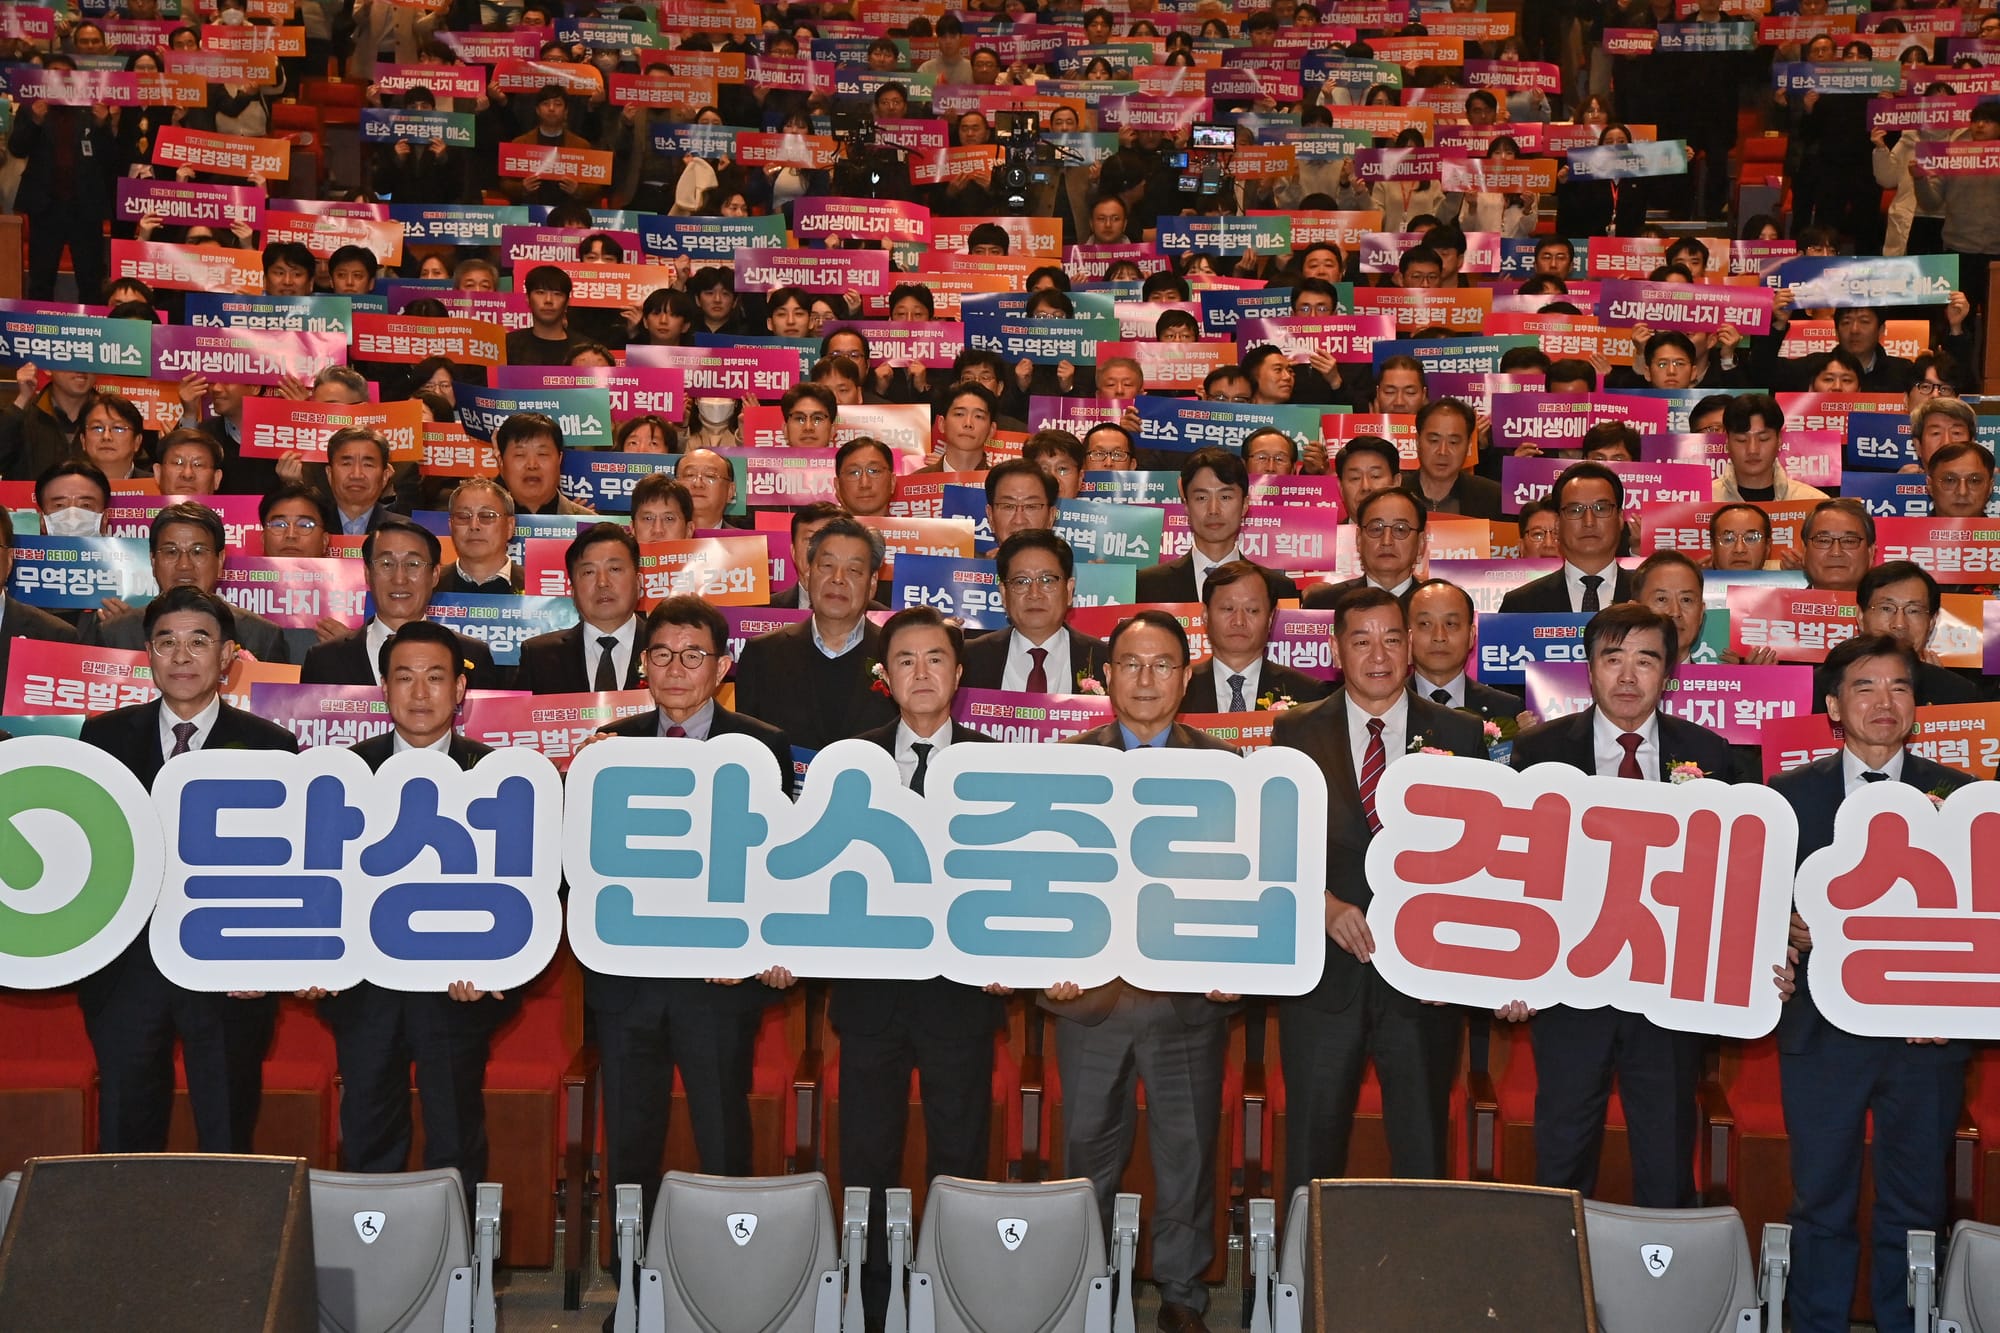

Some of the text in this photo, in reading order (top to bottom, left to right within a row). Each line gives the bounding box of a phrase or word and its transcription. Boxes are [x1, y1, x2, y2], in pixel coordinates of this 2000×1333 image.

[1304, 68, 1325, 82] 탄소
[1377, 72, 1398, 85] 해소
[1537, 75, 1556, 88] 확대
[456, 79, 480, 92] 확대
[838, 82, 860, 94] 탄소
[1873, 112, 1948, 125] 신재생에너지
[366, 122, 470, 140] 탄소 무역장벽 해소
[655, 138, 676, 150] 탄소
[920, 134, 943, 148] 확대
[159, 142, 247, 169] 글로벌경쟁력
[251, 156, 281, 172] 강화
[581, 164, 606, 178] 강화
[1526, 172, 1550, 187] 강화
[124, 197, 256, 222] 신재생에너지 확대
[429, 222, 488, 237] 무역장벽
[800, 215, 923, 235] 신재생에너지 확대
[646, 232, 678, 248] 탄소
[682, 235, 748, 251] 무역장벽
[1162, 232, 1285, 248] 탄소 무역장벽 해소
[231, 268, 264, 287] 강화
[744, 267, 880, 286] 신재생에너지 확대
[1209, 308, 1238, 325] 탄소
[1451, 307, 1483, 324] 강화
[1609, 301, 1718, 323] 신재생에너지
[1724, 307, 1762, 325] 확대
[36, 324, 102, 337] RE100 업무협약식
[13, 337, 142, 365] 무역장벽 해소
[359, 335, 499, 361] 글로벌경쟁력 강화
[971, 336, 1076, 357] 탄소 무역장벽
[1603, 338, 1635, 356] 강화
[1887, 339, 1919, 357] 강화
[159, 350, 286, 376] 신재생에너지
[754, 370, 790, 391] 확대
[496, 400, 559, 410] RE100 업무협약식
[634, 391, 673, 413] 확대
[1594, 405, 1628, 413] 업무협약식
[327, 415, 352, 425] RE100
[461, 408, 602, 437] 탄소 해소
[1211, 411, 1273, 424] RE100 업무협약식
[1140, 420, 1178, 440] 탄소
[1857, 438, 1898, 459] 탄소
[628, 464, 652, 473] RE100
[1787, 456, 1830, 477] 확대
[1282, 487, 1321, 496] 업무협약식
[1063, 512, 1107, 524] 업무협약식
[1103, 535, 1149, 558] 해소
[1275, 534, 1322, 558] 확대
[48, 550, 77, 561] RE100
[15, 567, 121, 594] 무역장벽
[249, 571, 279, 581] RE100
[703, 569, 756, 596] 강화
[954, 571, 993, 584] 힘쎈충남
[904, 586, 954, 614] 탄소
[469, 608, 498, 618] RE100
[1792, 603, 1837, 617] 힘쎈충남
[1285, 622, 1327, 635] 힘쎈충남
[1533, 627, 1576, 638] 힘쎈충남
[1482, 646, 1535, 671] 탄소
[81, 662, 131, 677] 힘쎈충남
[1683, 680, 1741, 692] 업무협약식
[532, 708, 577, 722] 힘쎈충남
[971, 704, 1045, 719] 힘쎈충남 RE100
[1208, 728, 1238, 739] RE100
[1924, 720, 1984, 733] 업무협약식
[178, 774, 535, 960] 달성
[590, 762, 1297, 965] 탄소중립
[1395, 784, 1766, 1006] 경제
